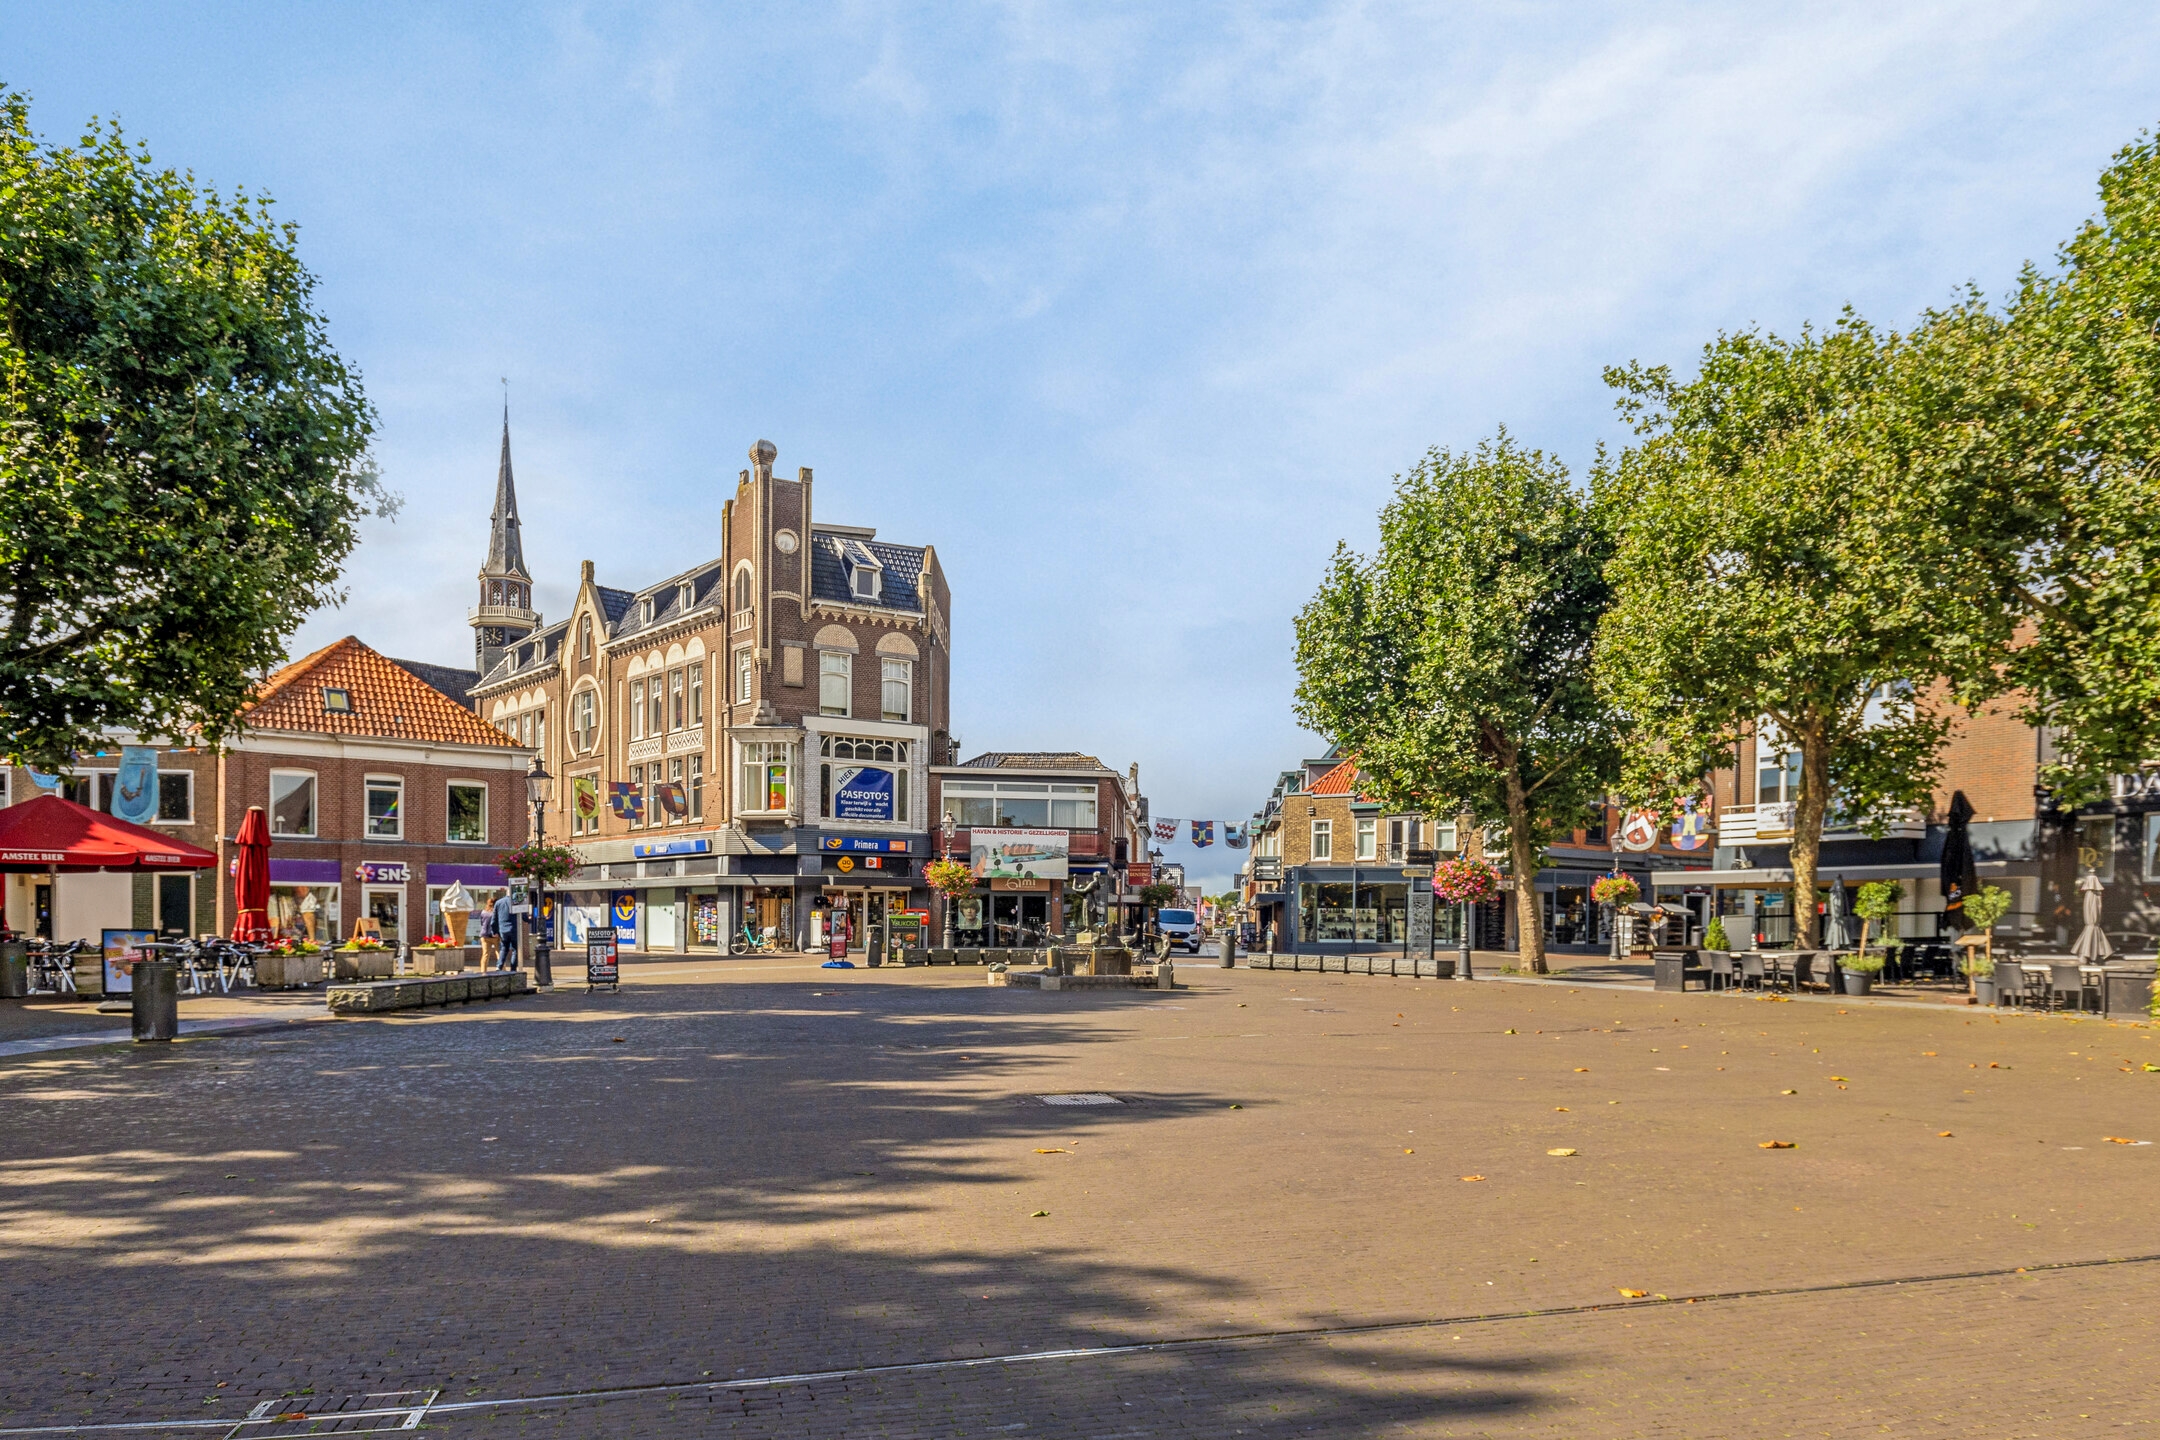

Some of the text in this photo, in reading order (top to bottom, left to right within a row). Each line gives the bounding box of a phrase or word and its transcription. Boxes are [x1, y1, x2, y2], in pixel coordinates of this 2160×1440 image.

[838, 769, 854, 784] HIER
[841, 790, 889, 800] PASFOTO'S
[854, 840, 878, 850] Primera
[377, 868, 411, 881] SNS
